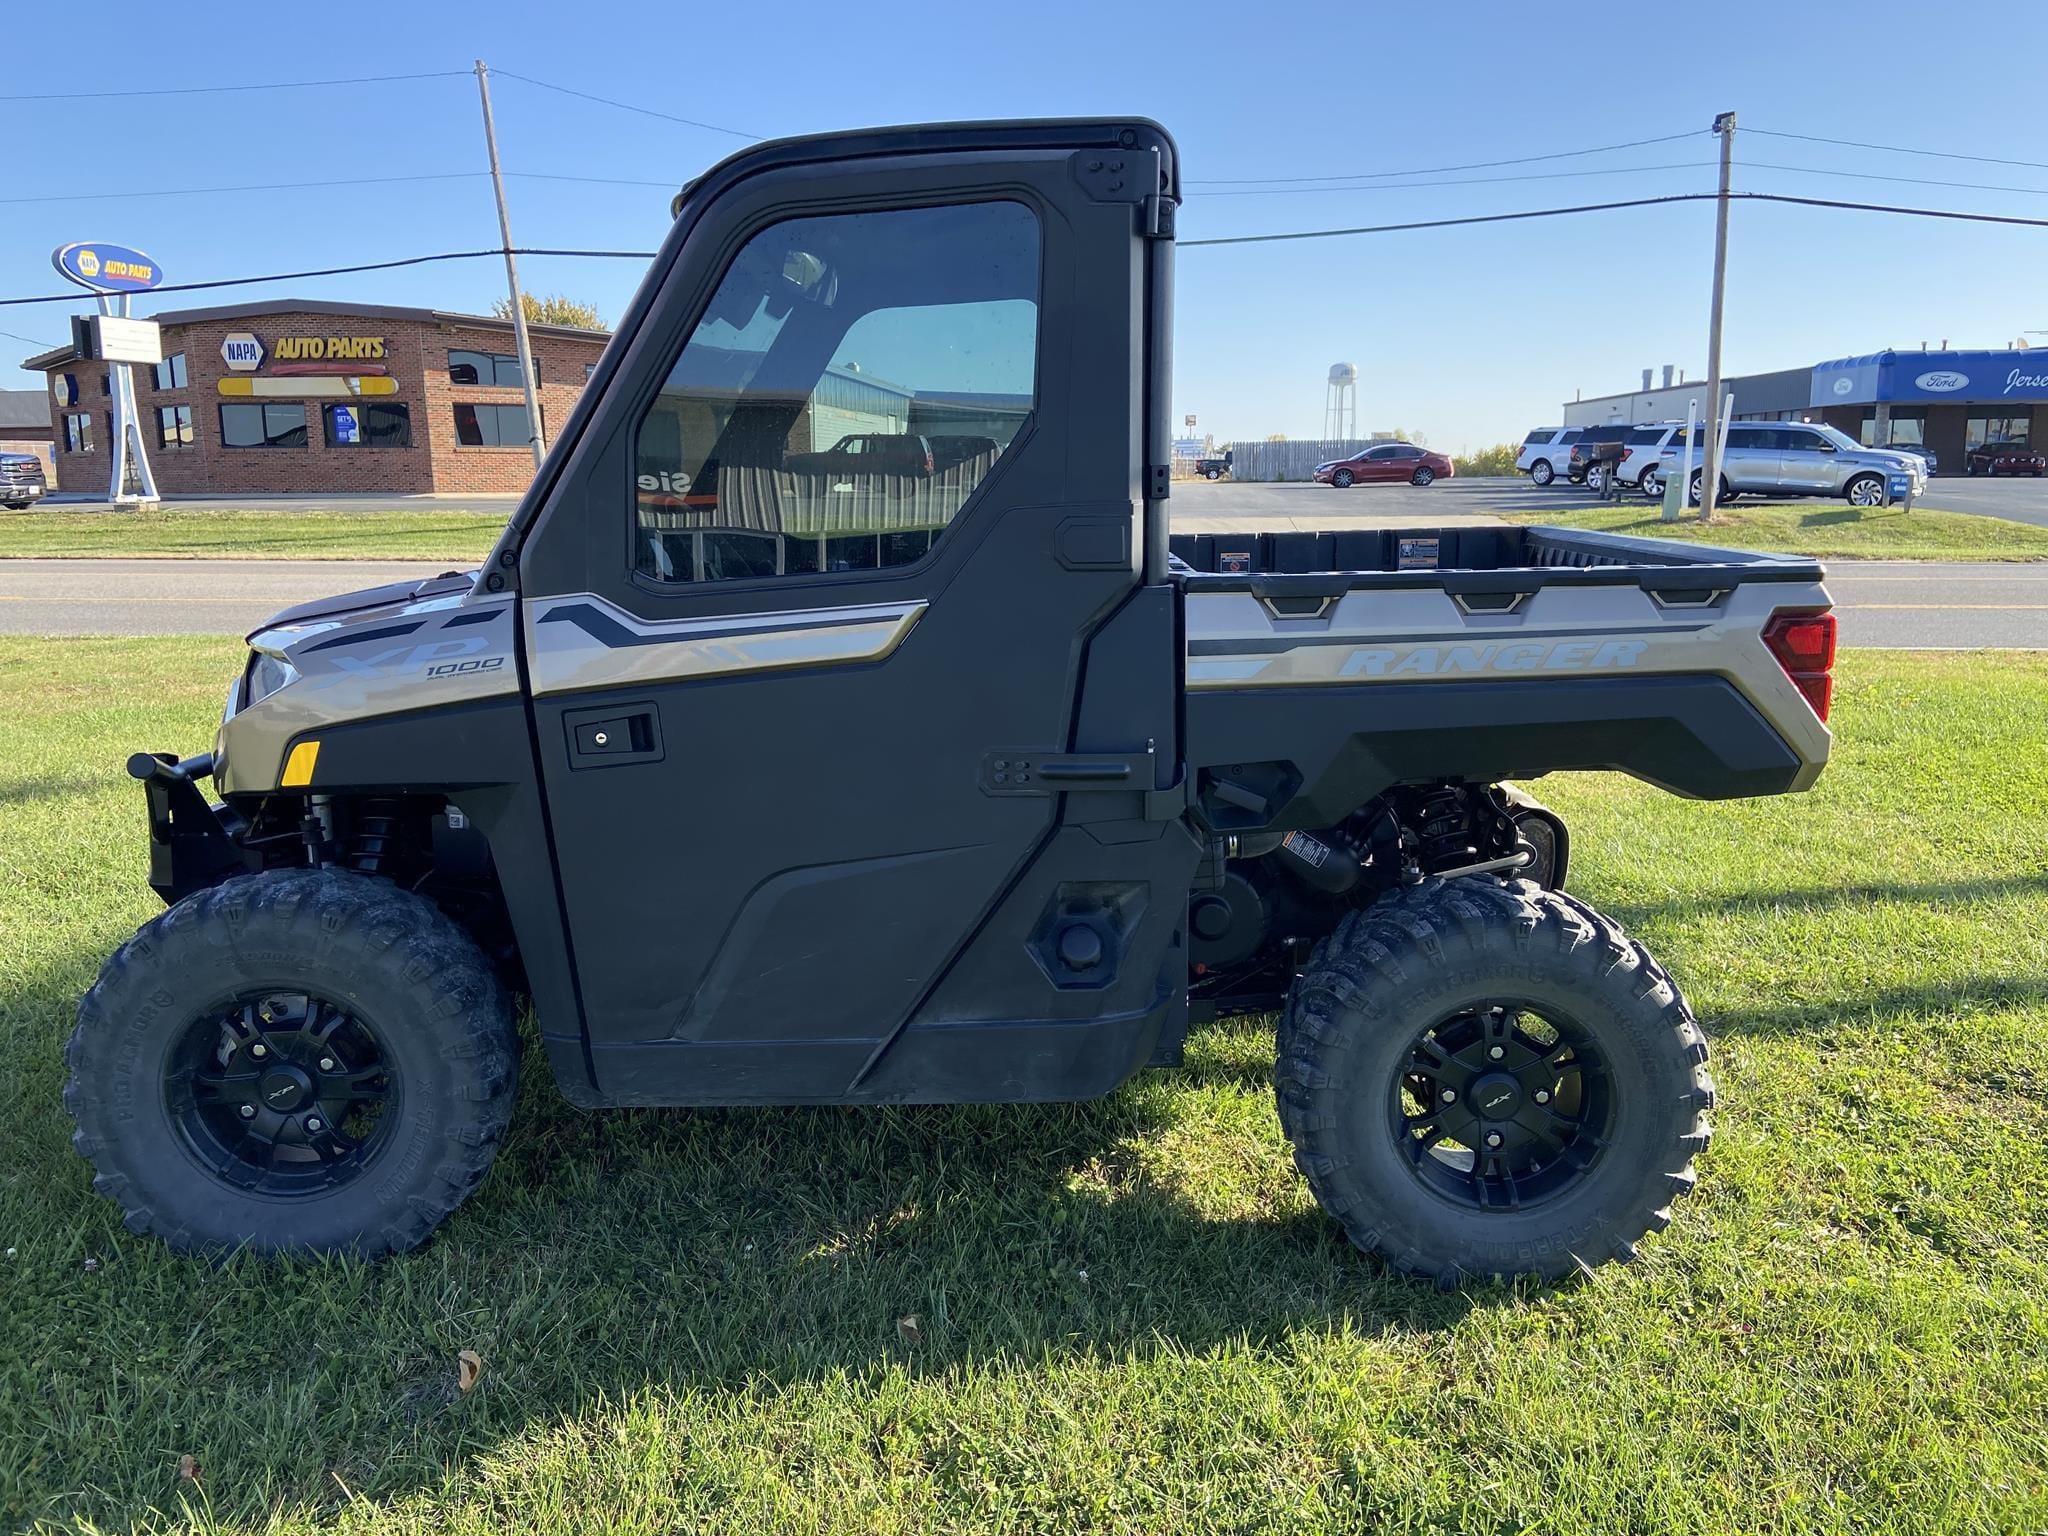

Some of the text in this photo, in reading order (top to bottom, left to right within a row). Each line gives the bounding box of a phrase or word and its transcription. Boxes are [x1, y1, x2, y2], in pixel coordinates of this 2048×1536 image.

[81, 256, 152, 280] NAPA AUTO PARTS
[227, 336, 385, 361] NAPA AUTO PARTS
[1926, 374, 1959, 388] Ford
[314, 637, 505, 689] XP 1000
[1337, 640, 1649, 677] RANGER
[268, 1085, 295, 1100] XP
[1485, 1092, 1512, 1108] XP
